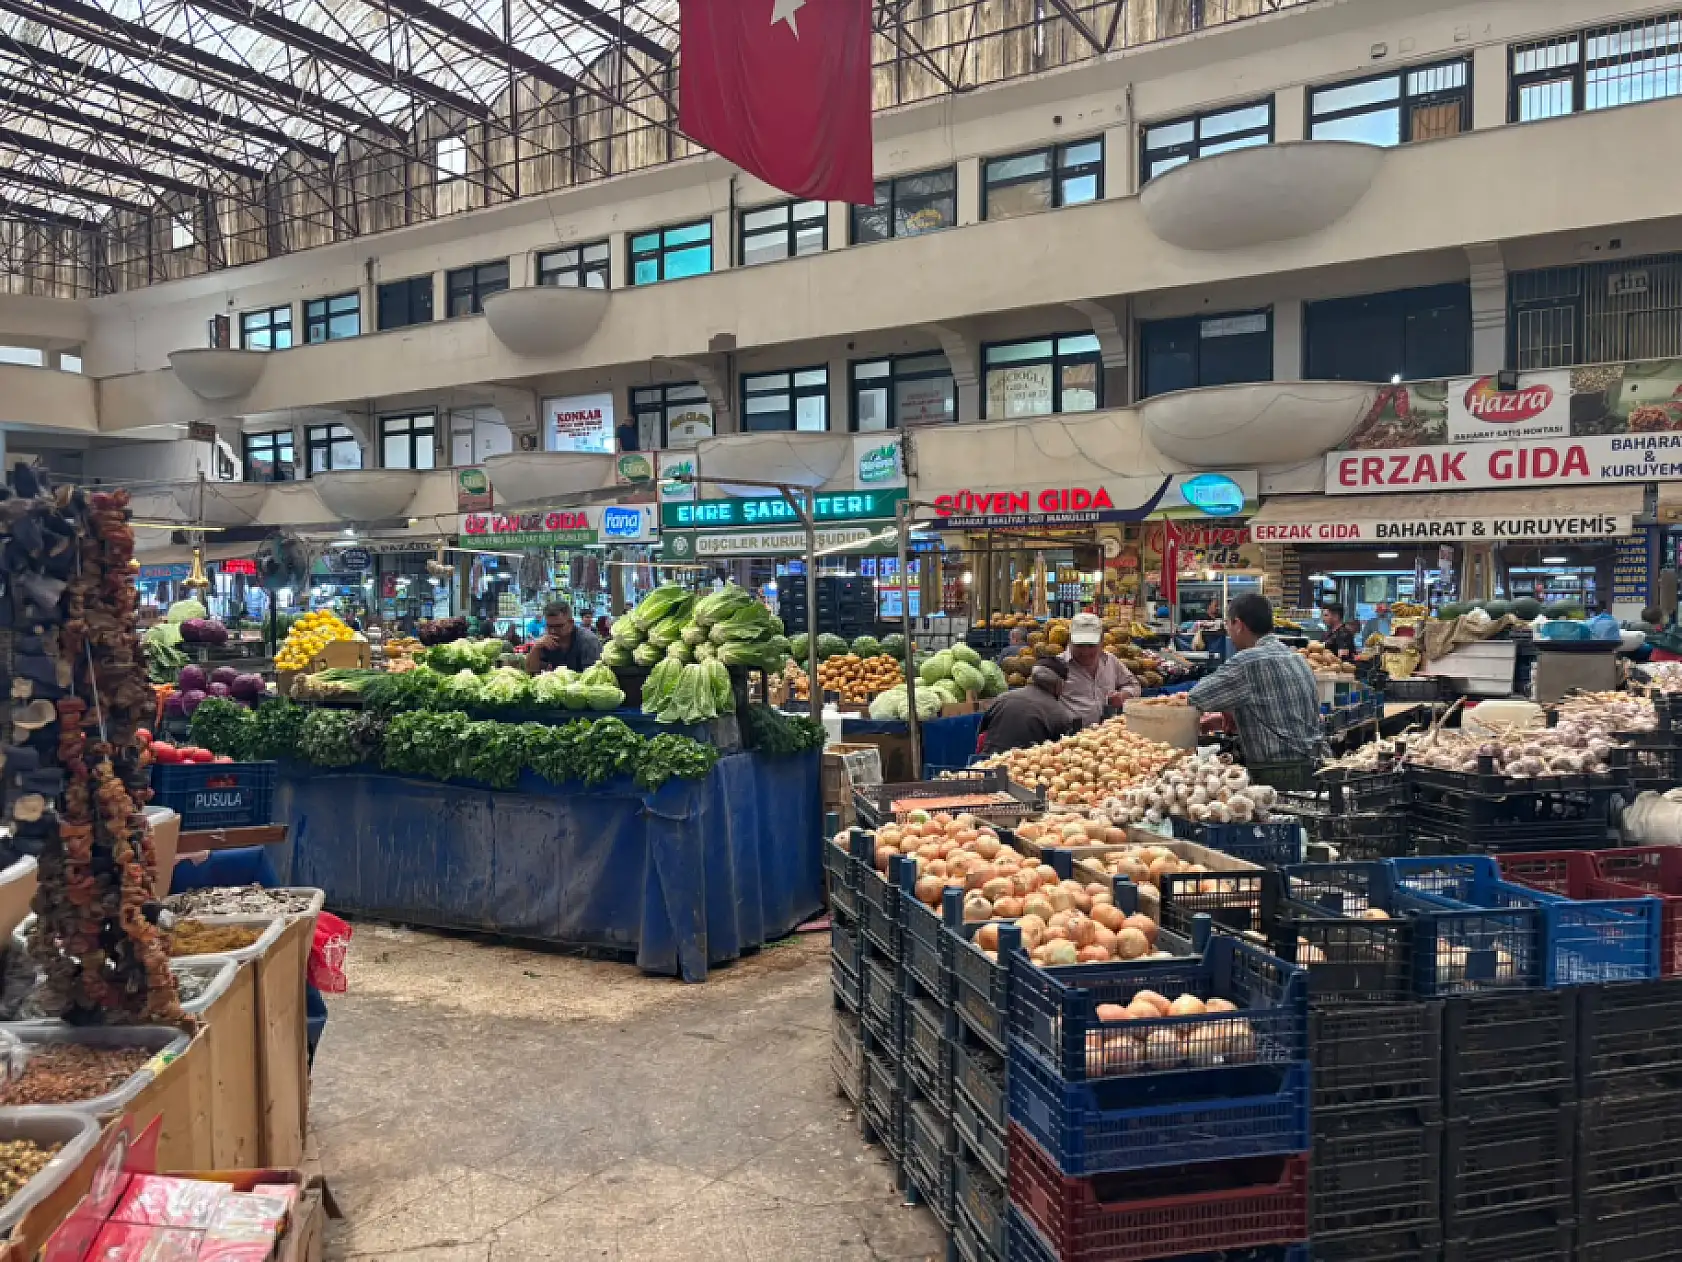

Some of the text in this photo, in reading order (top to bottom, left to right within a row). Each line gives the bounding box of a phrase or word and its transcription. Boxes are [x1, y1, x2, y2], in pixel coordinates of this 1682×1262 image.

[1469, 391, 1547, 415] Hazra
[1611, 435, 1682, 452] BAHARA
[1338, 445, 1591, 487] ERZAK GIDA
[1644, 450, 1655, 463] &
[934, 486, 1115, 518] GÜVEN GIDA
[545, 511, 590, 530] GIDA
[677, 503, 731, 522] EMRE
[1256, 523, 1313, 540] ERZAK
[1319, 523, 1361, 539] GIDA
[1376, 521, 1467, 539] BAHARAT
[1472, 520, 1486, 536] &
[1493, 513, 1617, 535] KURUYEMİŞ
[195, 792, 242, 808] PUSULA
